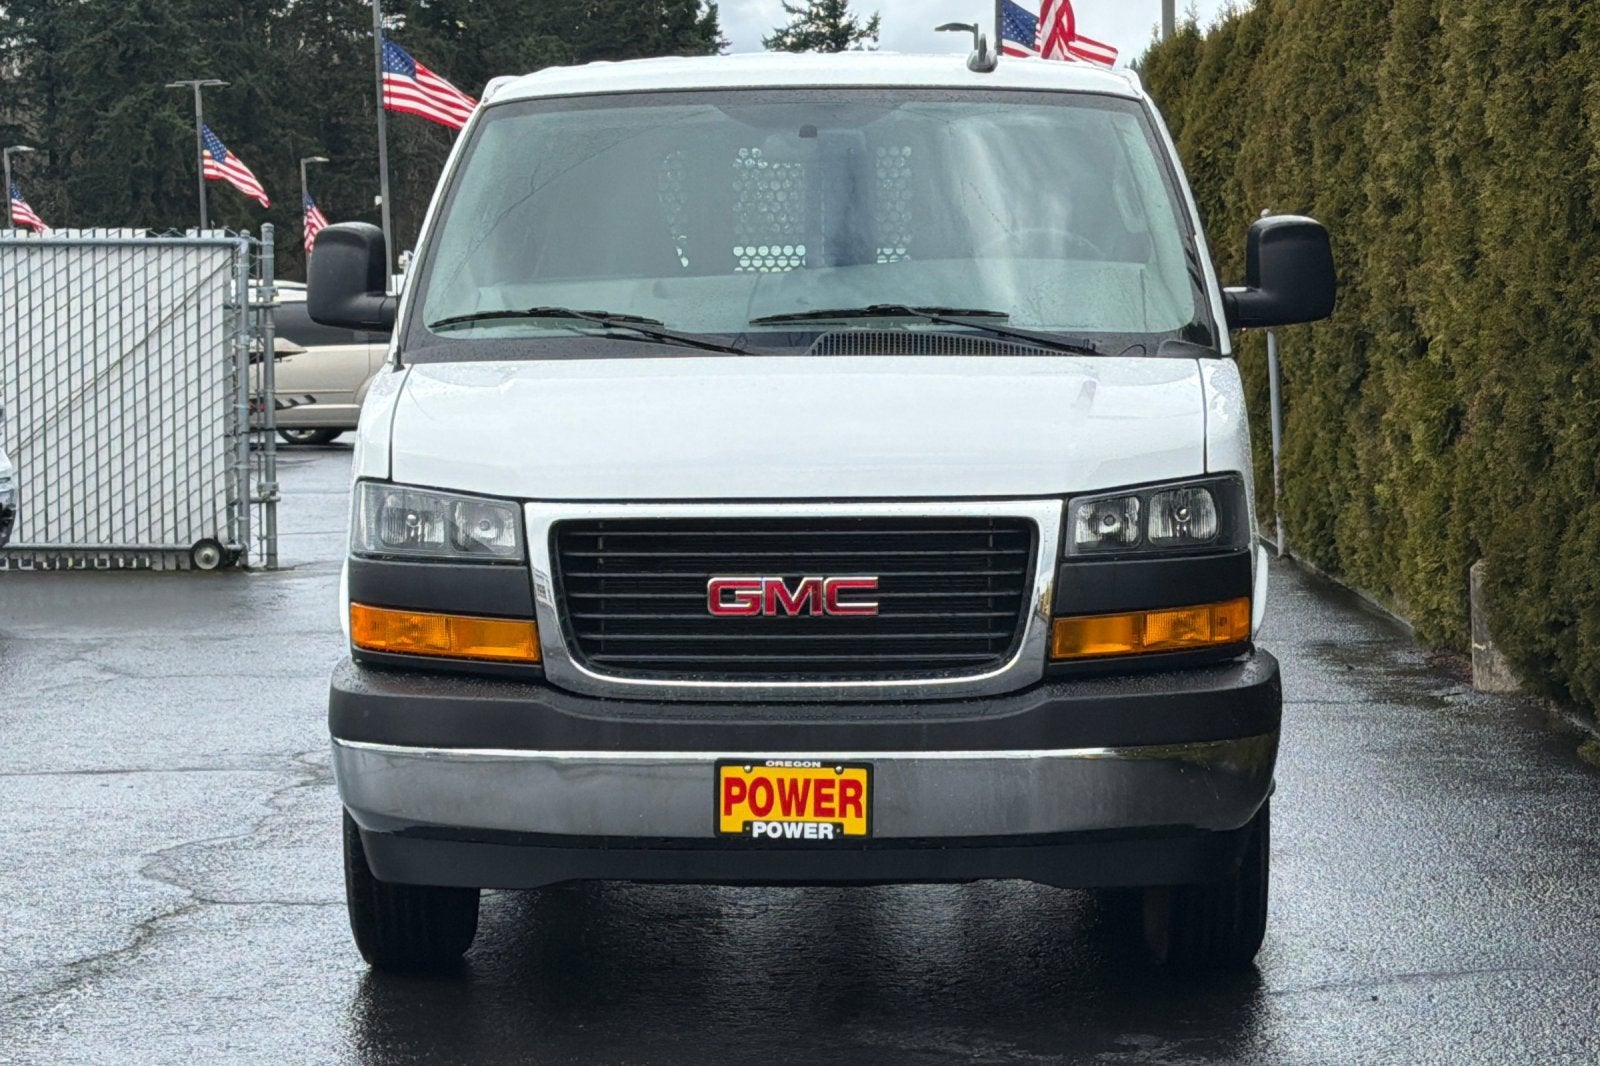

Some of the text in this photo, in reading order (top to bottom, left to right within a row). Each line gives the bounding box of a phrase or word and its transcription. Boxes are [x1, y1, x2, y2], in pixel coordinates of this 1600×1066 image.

[707, 576, 879, 616] GMC
[765, 760, 821, 768] OREGON
[723, 776, 863, 818] POWER
[752, 821, 834, 839] POWER
